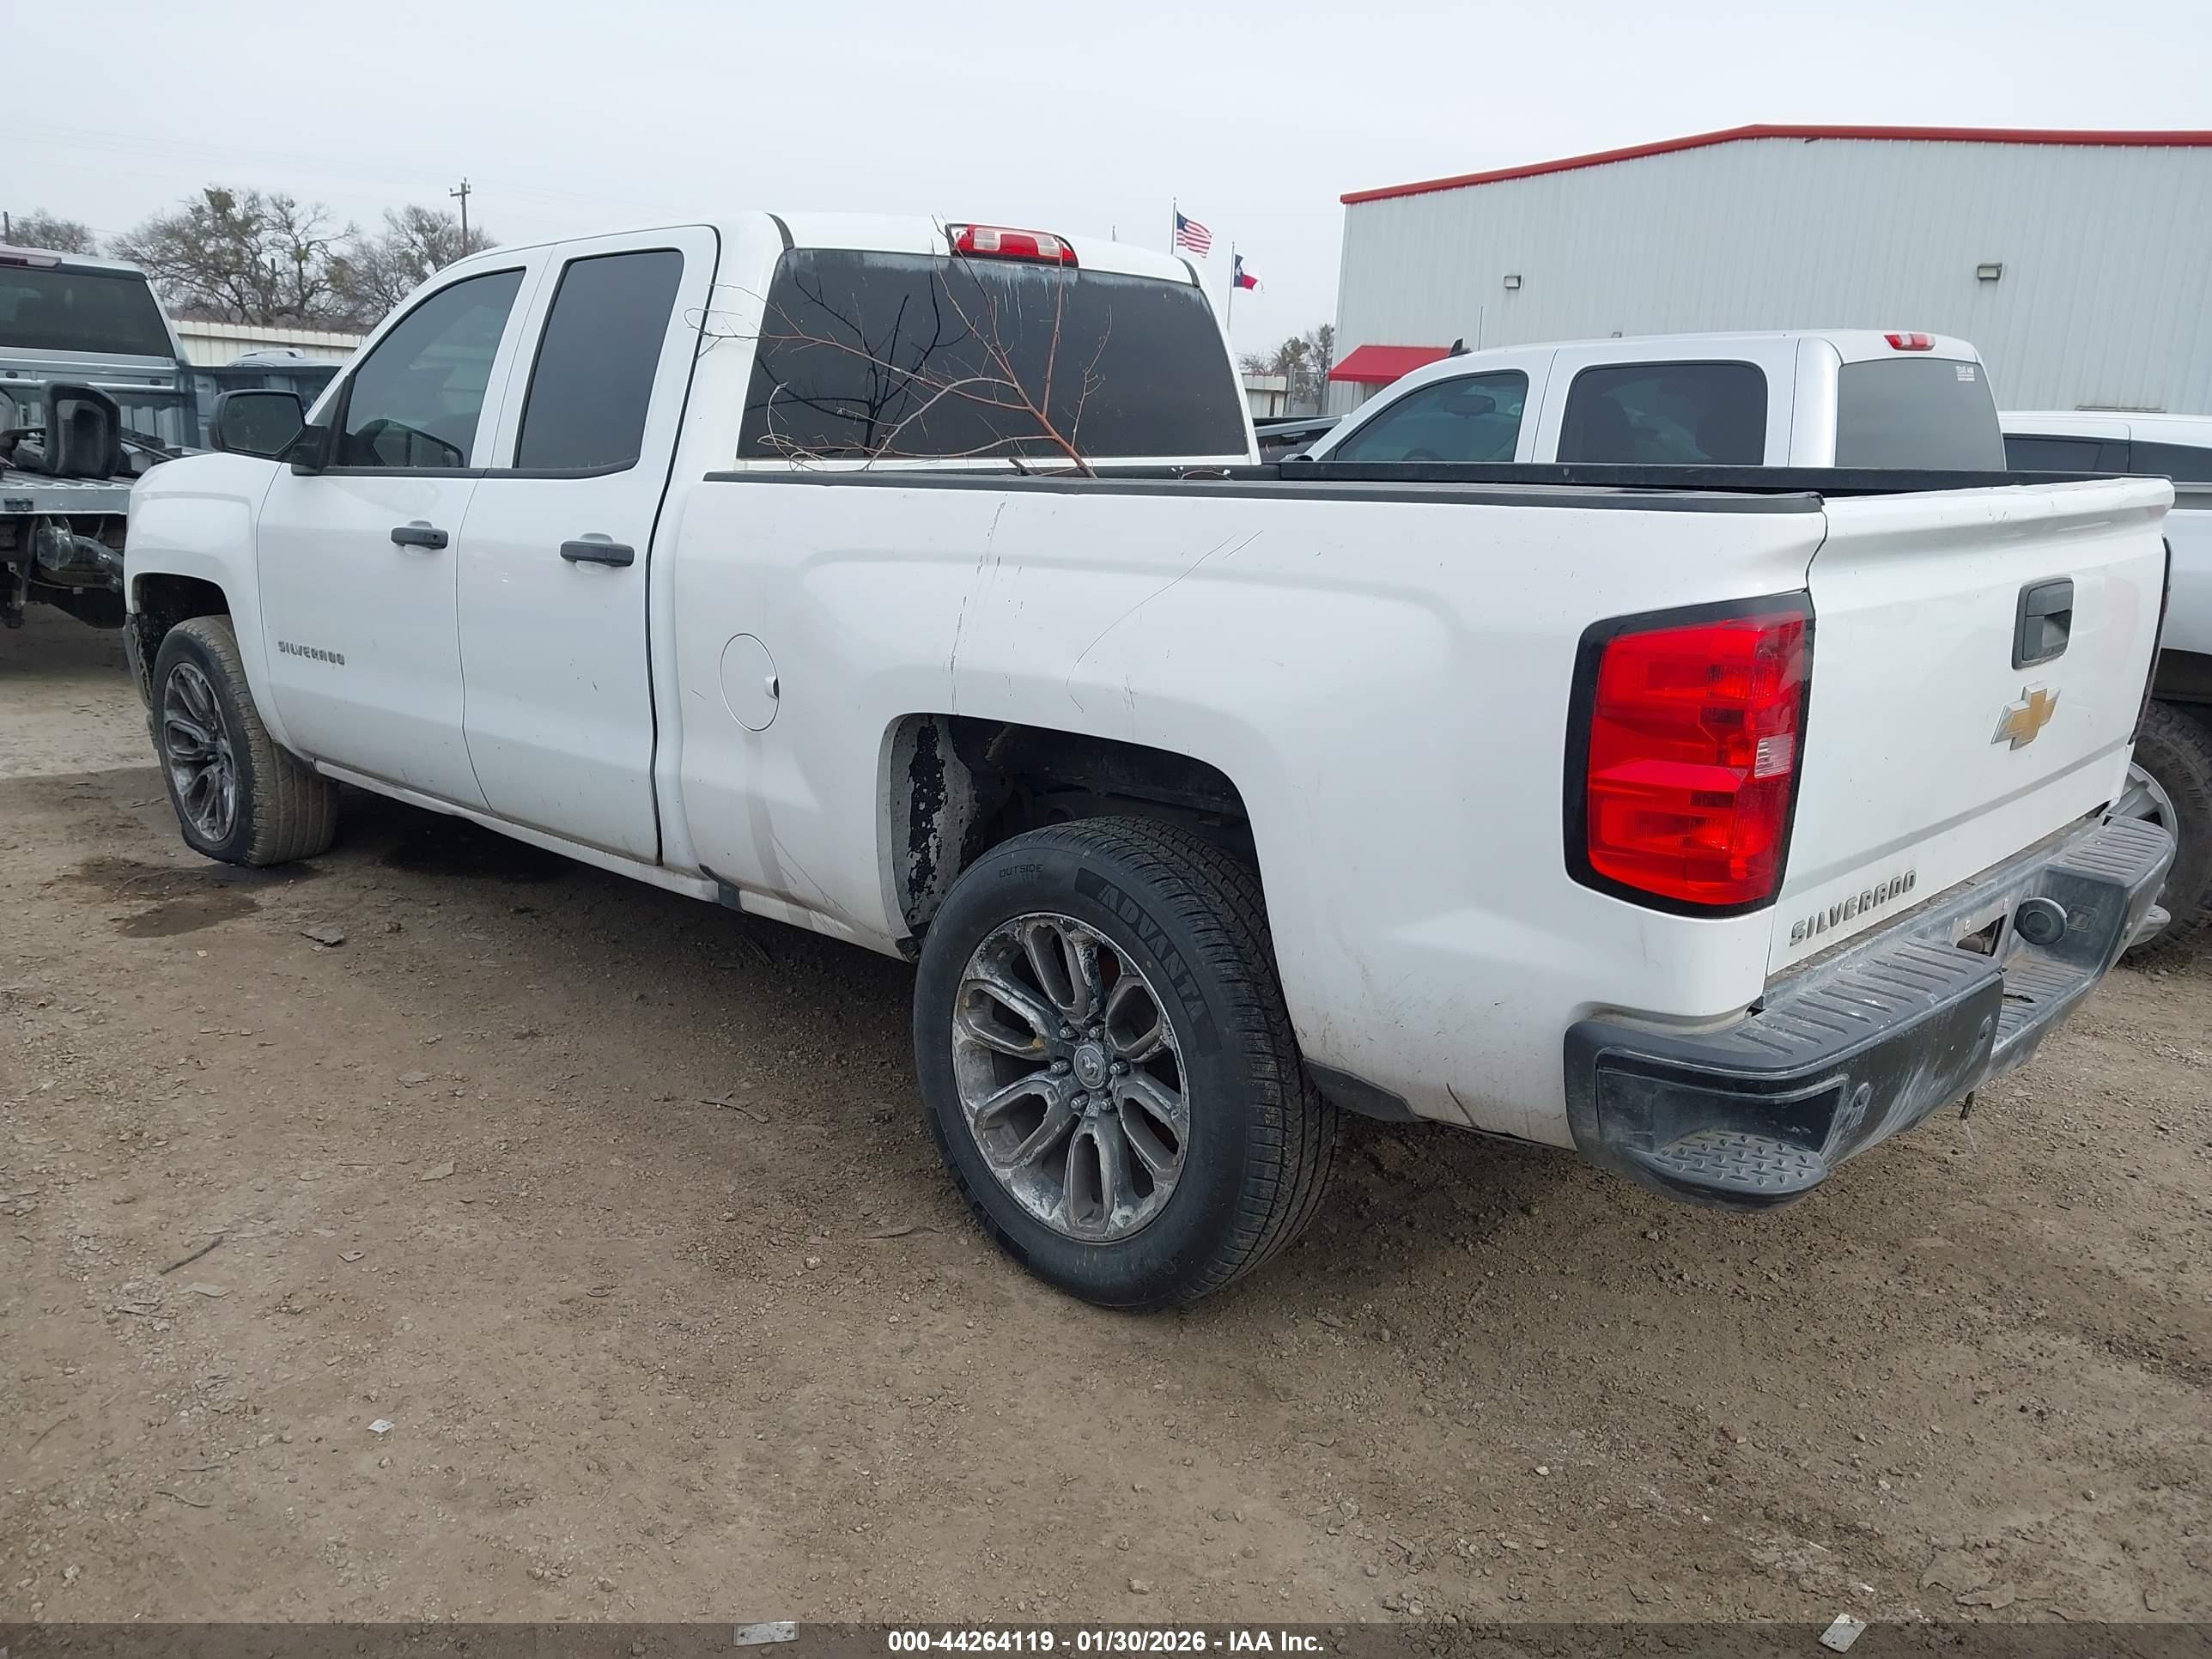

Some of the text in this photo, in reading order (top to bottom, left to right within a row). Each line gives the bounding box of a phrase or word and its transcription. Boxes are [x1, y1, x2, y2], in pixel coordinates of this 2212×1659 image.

[277, 641, 345, 666] SILVERADO
[999, 864, 1044, 878] OUTSIDE
[1789, 869, 1917, 947] SILVERADO
[1097, 882, 1206, 1025] ADVANTA
